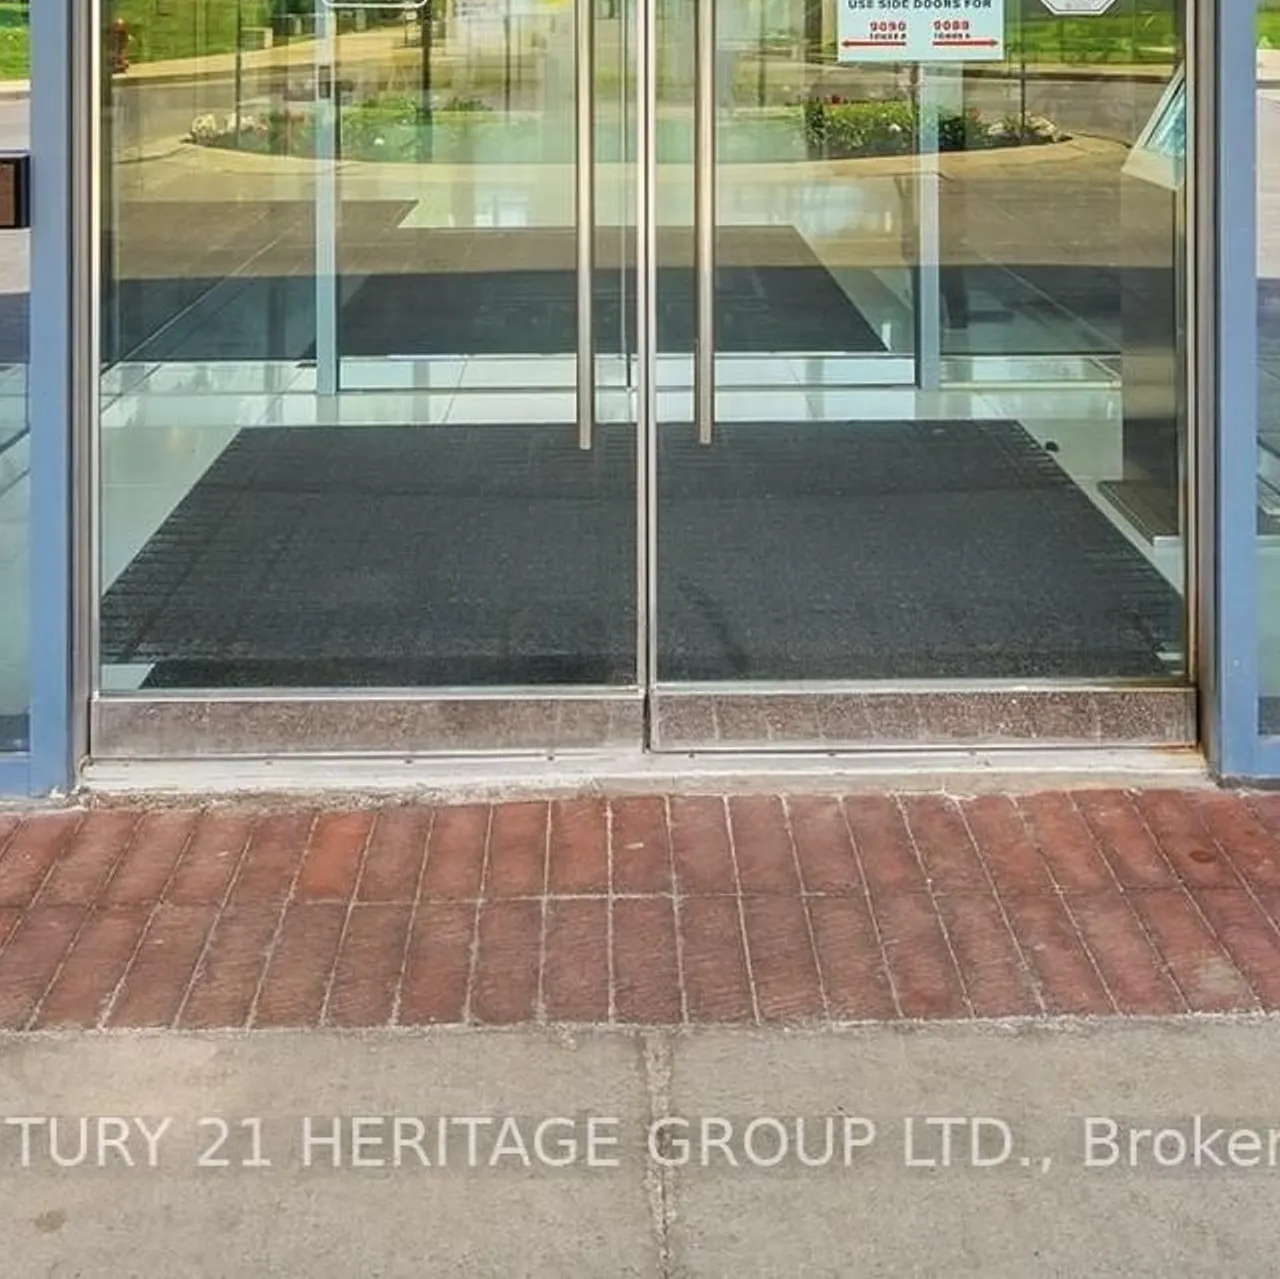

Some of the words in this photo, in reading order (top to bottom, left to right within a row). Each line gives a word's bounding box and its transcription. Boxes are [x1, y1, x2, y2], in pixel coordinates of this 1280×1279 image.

[848, 0, 873, 9] USE
[878, 0, 909, 9] SIDE
[913, 0, 961, 9] DOORS
